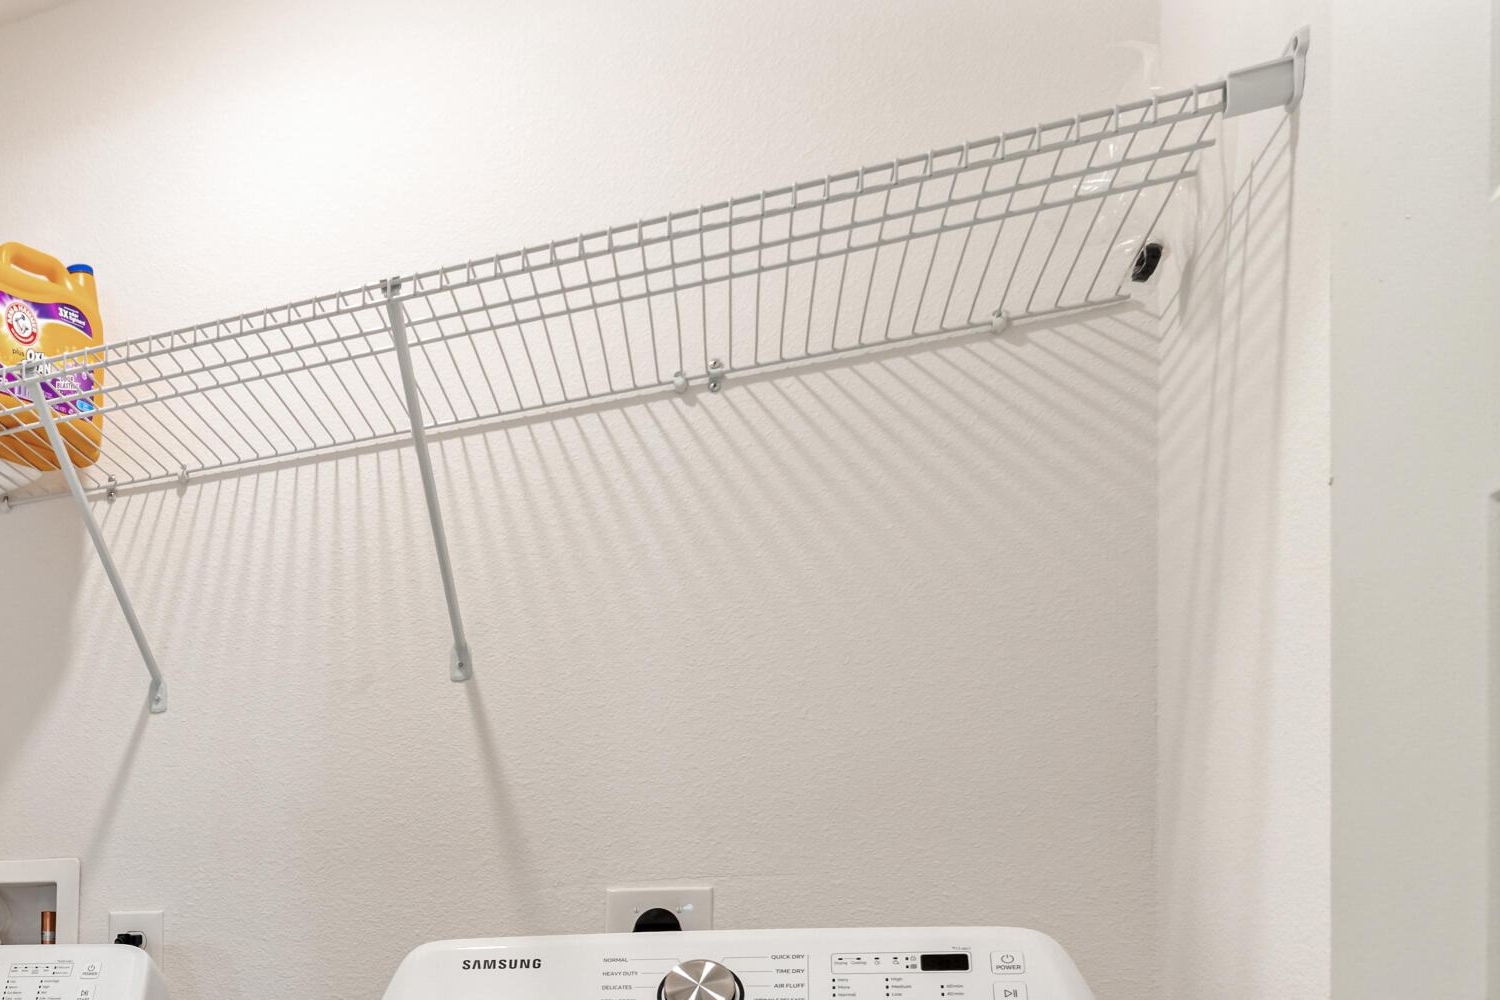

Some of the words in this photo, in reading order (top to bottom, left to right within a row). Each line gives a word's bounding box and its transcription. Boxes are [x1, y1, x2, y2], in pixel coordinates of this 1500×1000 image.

[58, 307, 70, 320] 3X
[12, 348, 25, 357] plus
[462, 958, 542, 970] SAMSUNG
